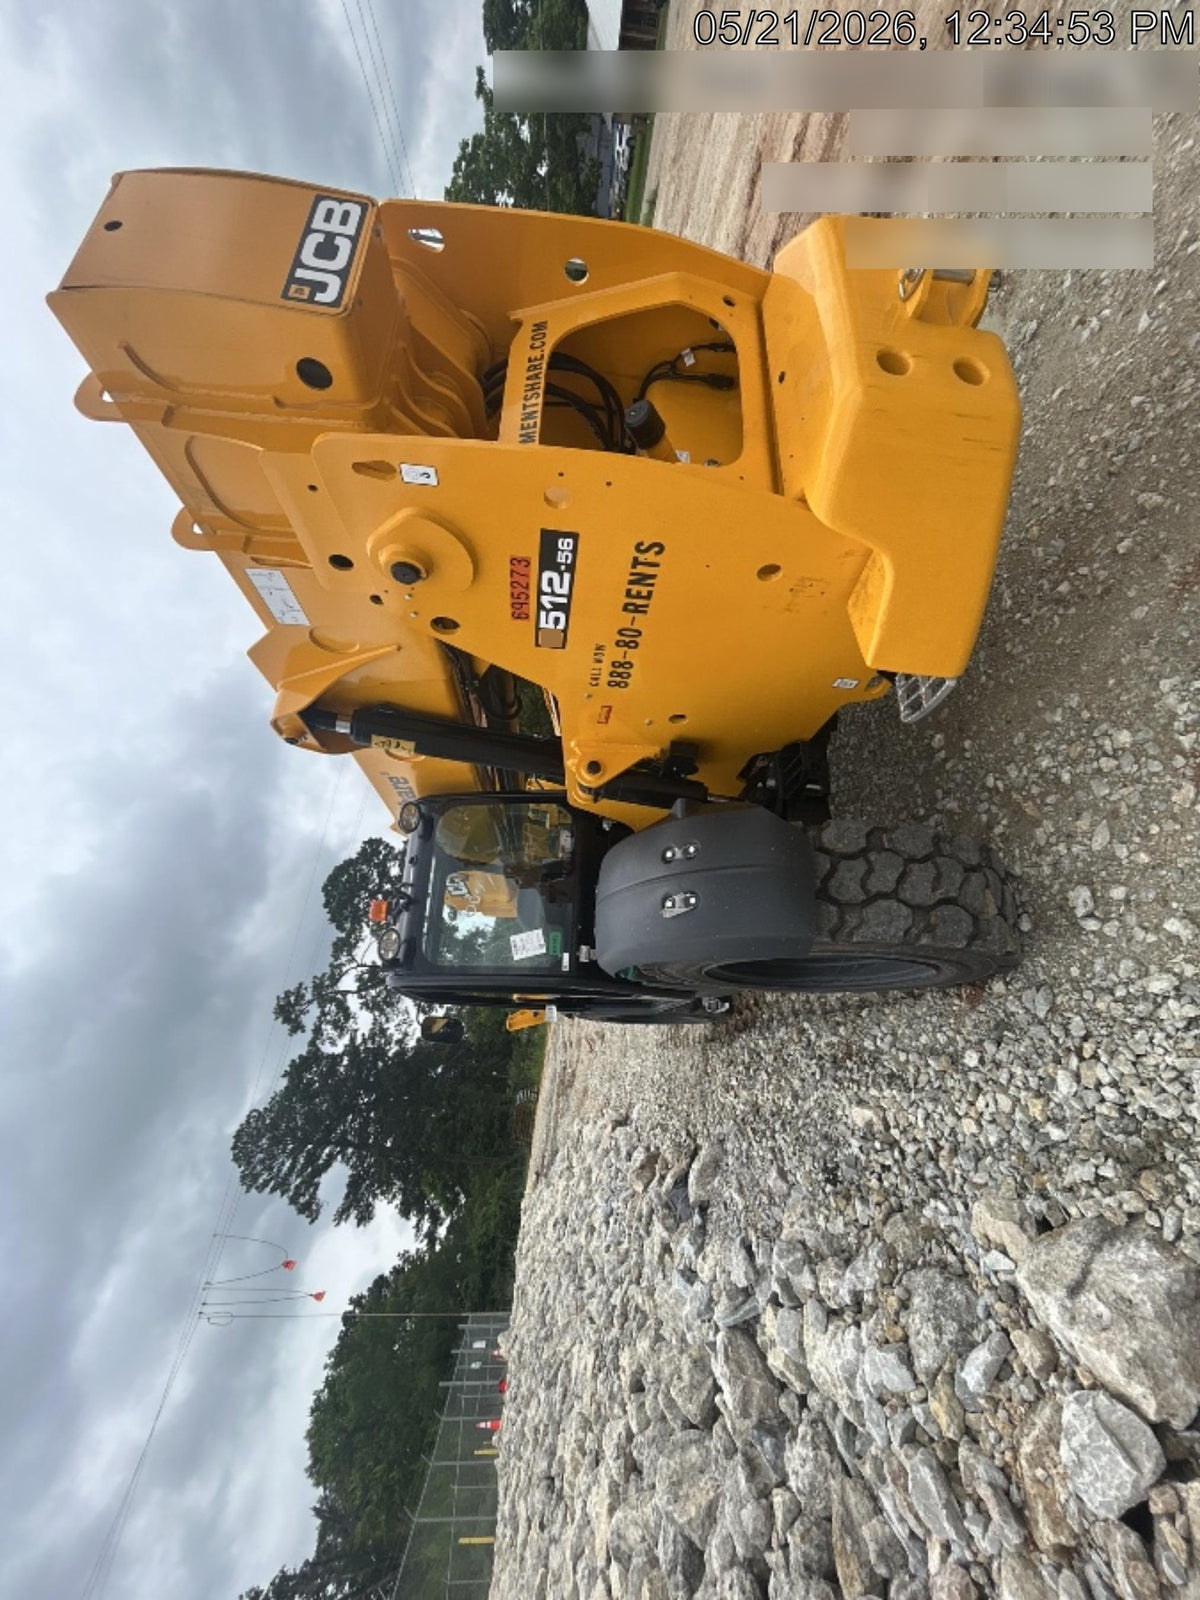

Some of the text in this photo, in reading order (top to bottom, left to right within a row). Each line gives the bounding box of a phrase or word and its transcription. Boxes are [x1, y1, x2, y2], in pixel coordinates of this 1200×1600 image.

[294, 199, 362, 303] JCB
[519, 321, 547, 444] MENTSHARE.COM
[511, 558, 530, 620] 695273
[608, 542, 665, 688] 888-80-RENTS
